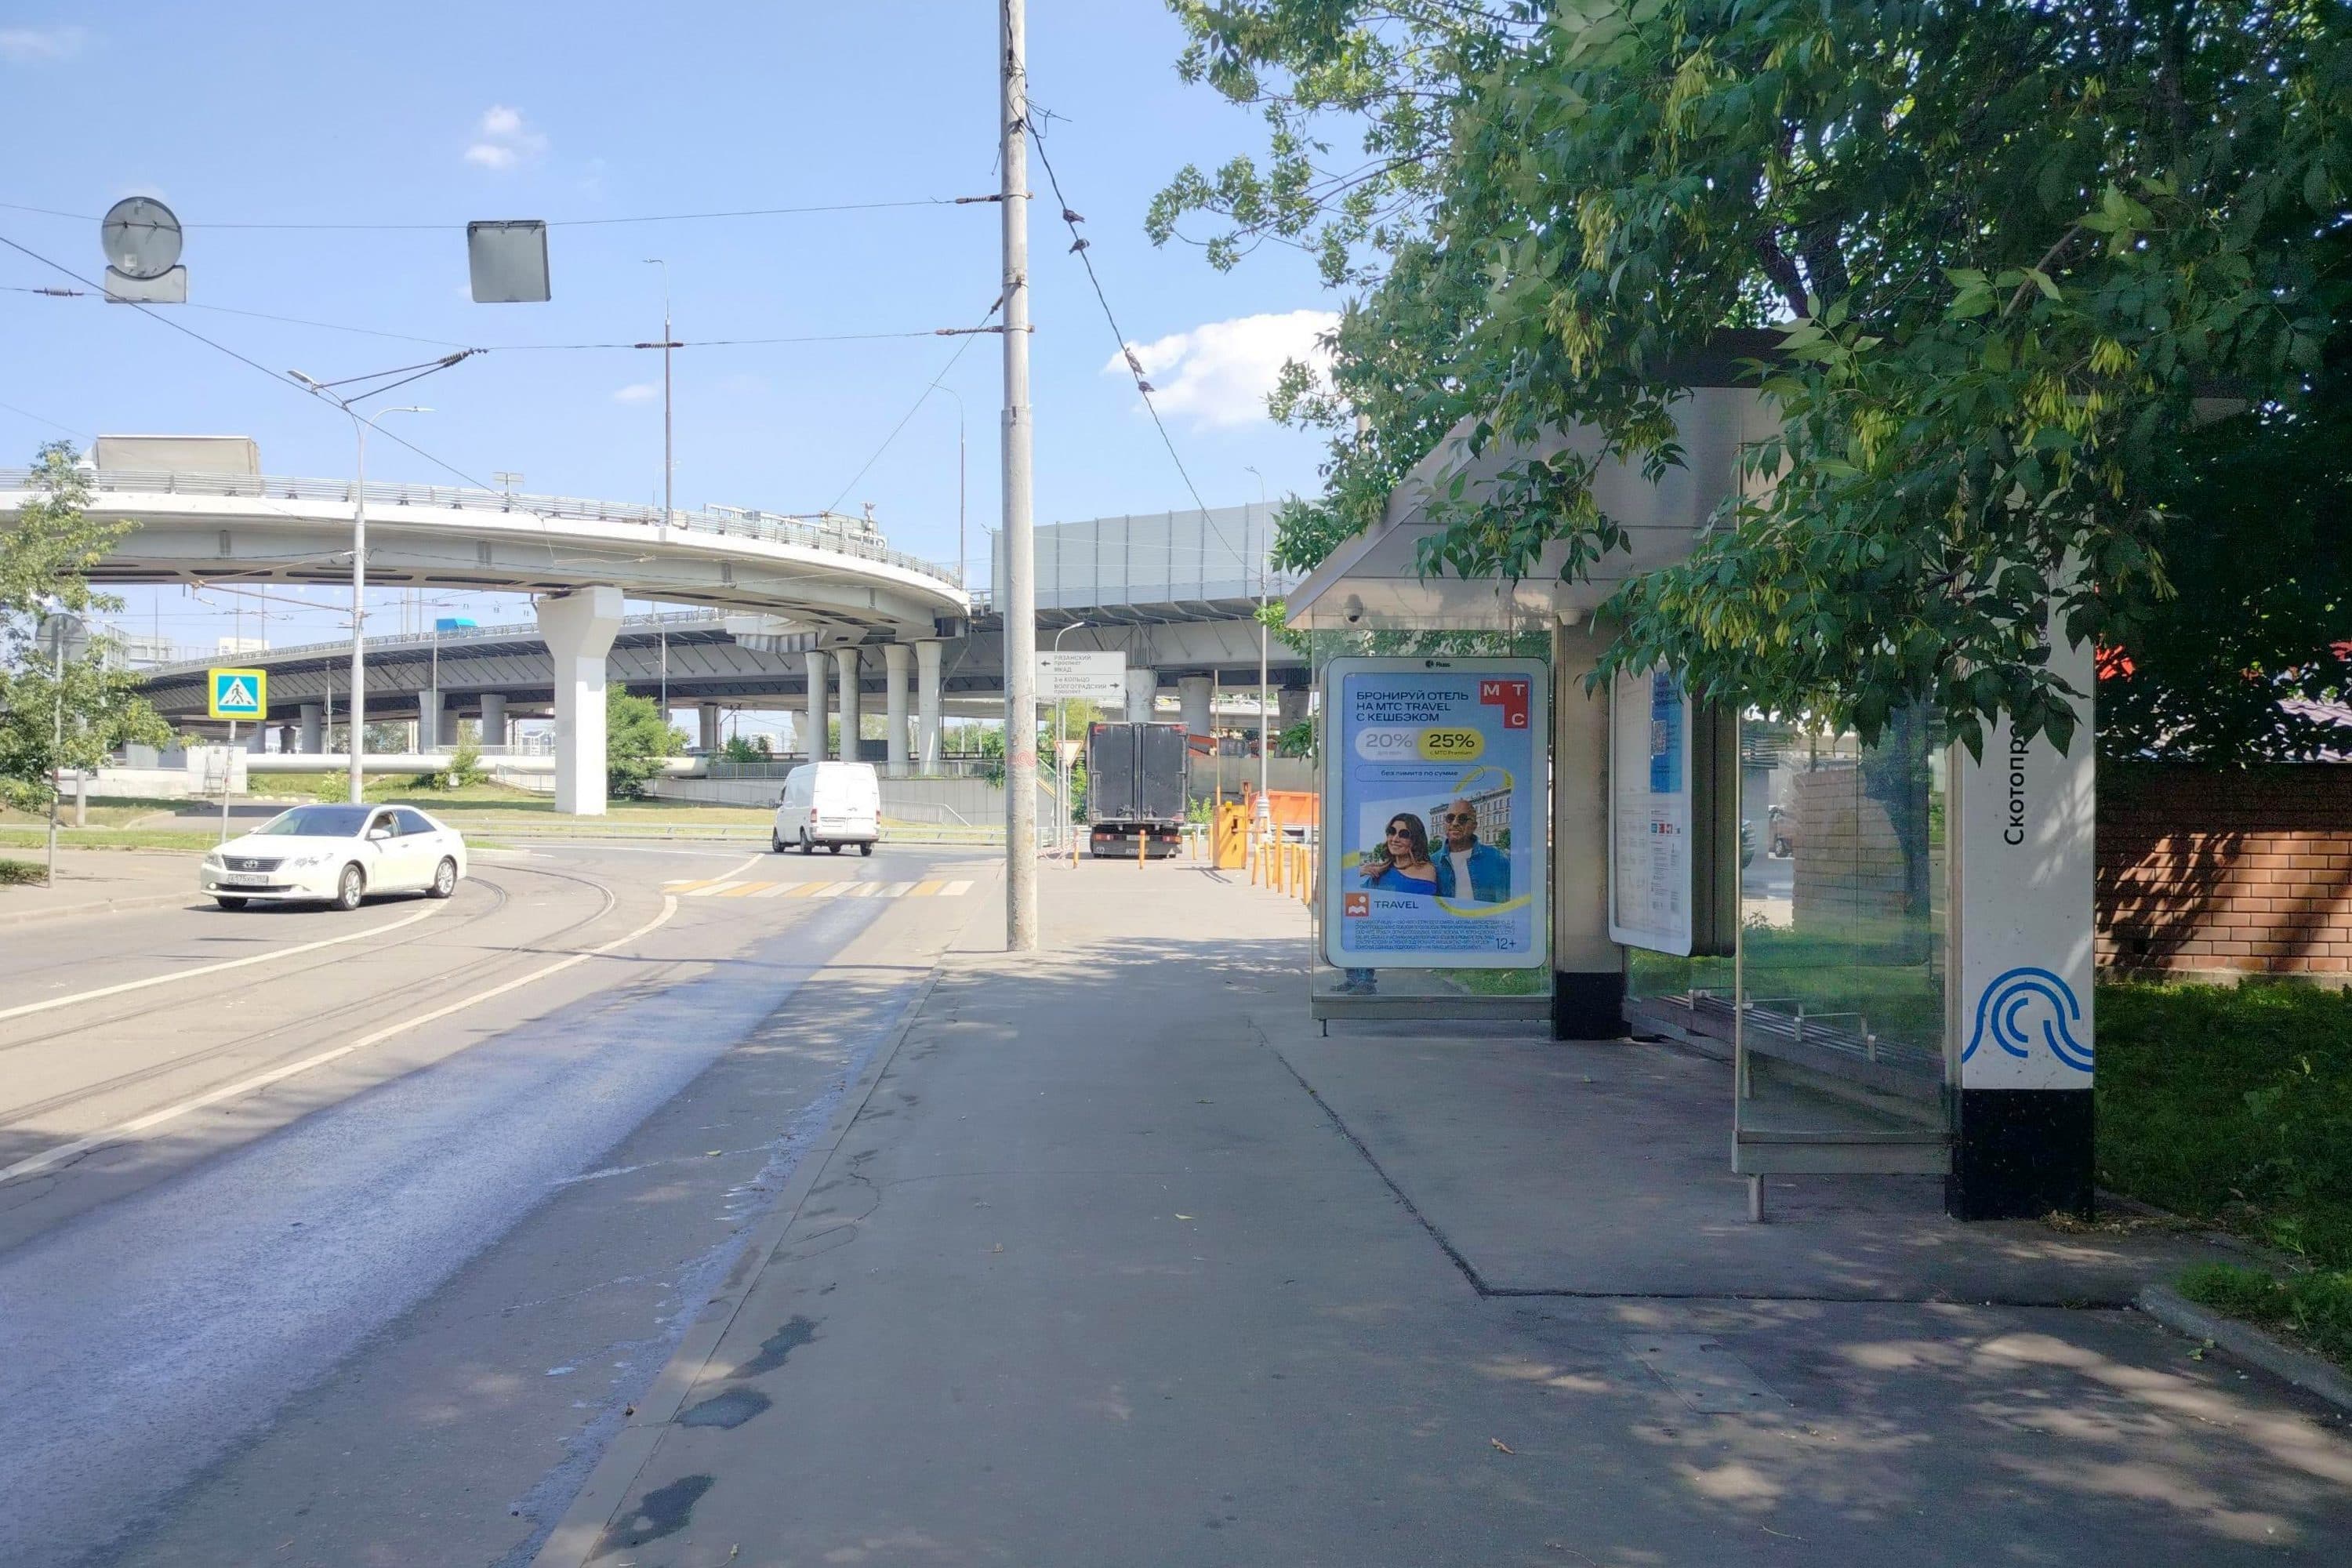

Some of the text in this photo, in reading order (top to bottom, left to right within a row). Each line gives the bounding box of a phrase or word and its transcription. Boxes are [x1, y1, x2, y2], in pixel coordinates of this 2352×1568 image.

[1356, 690, 1468, 700] БРОНИРУЙ ОТЕЛЬ
[1405, 702, 1451, 711] TRAVEL
[1356, 713, 1439, 721] С КЕШБЭКОМ
[1366, 734, 1475, 748] 20% 25%
[2004, 715, 2029, 845] Скотопр
[1374, 900, 1419, 909] TRAVEL
[1495, 938, 1516, 950] 12+
